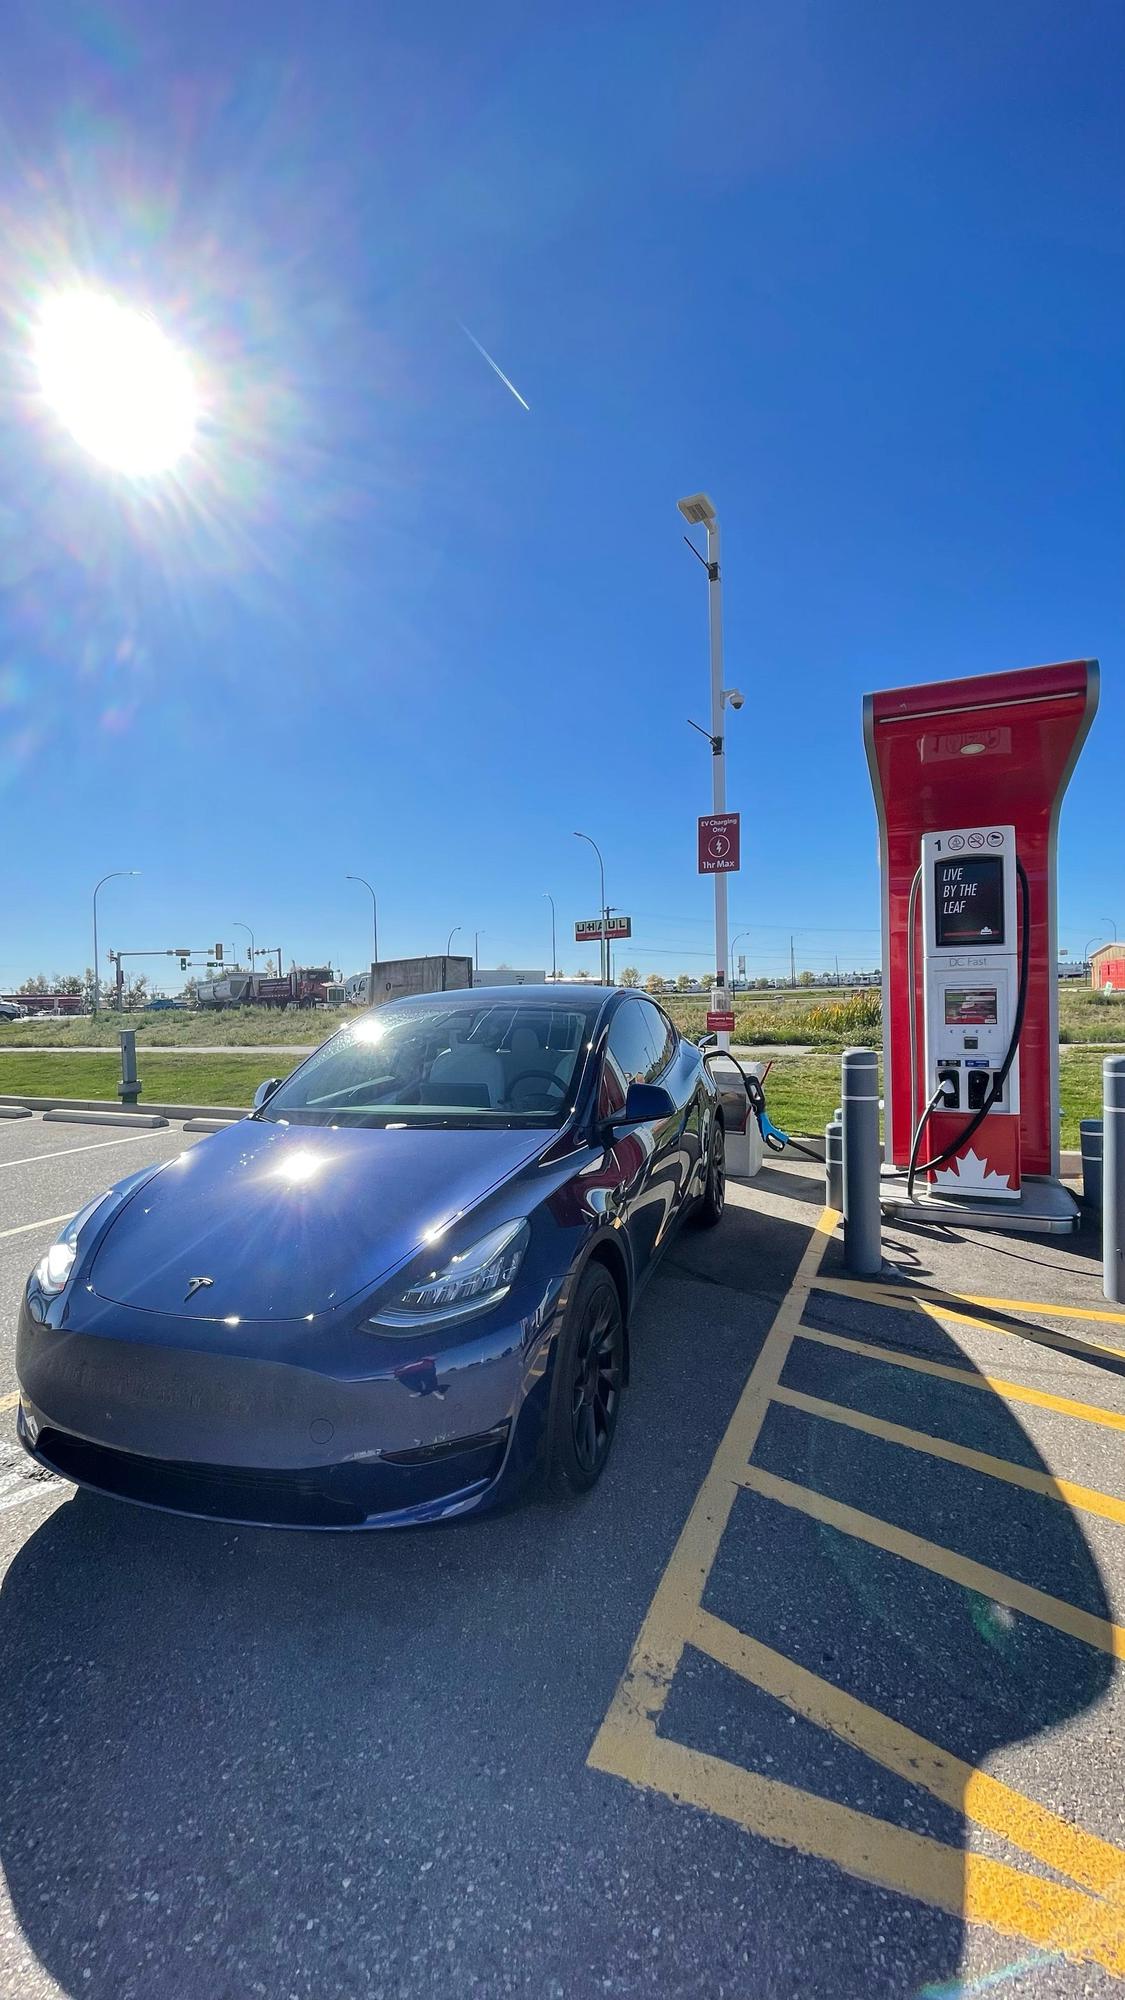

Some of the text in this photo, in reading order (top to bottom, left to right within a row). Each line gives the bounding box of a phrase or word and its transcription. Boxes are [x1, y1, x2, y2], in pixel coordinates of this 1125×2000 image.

[934, 839, 942, 852] 1
[702, 860, 735, 869] 1hr Max
[943, 867, 964, 882] LIVE
[943, 882, 978, 898] BY THE
[943, 900, 966, 915] LEAF
[949, 957, 987, 967] DC Fast
